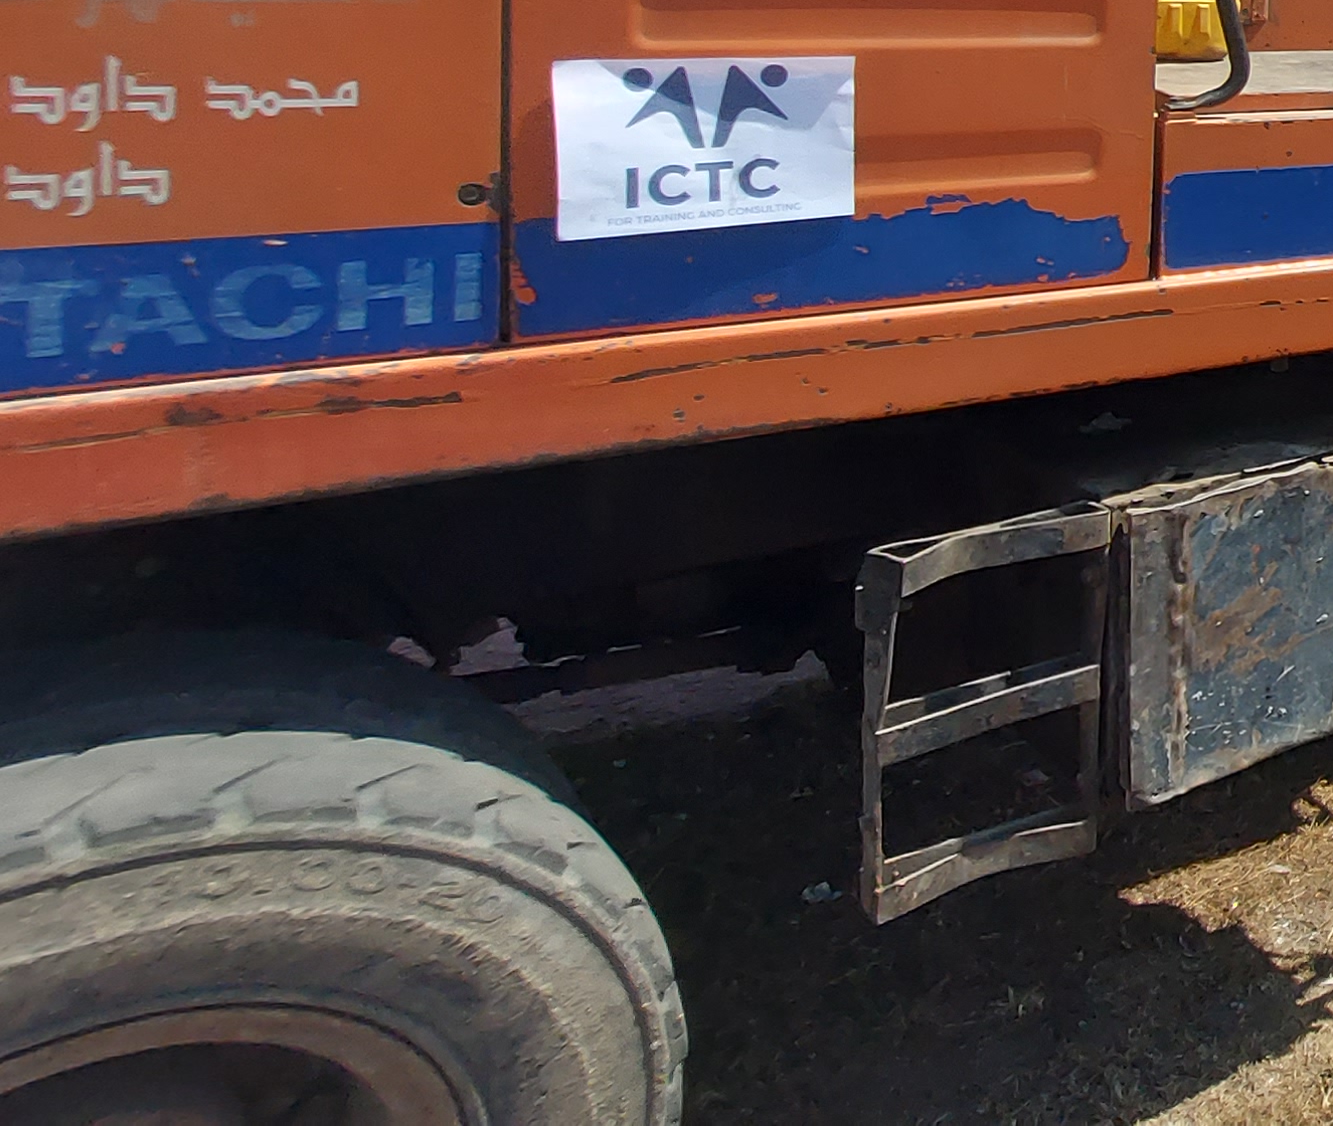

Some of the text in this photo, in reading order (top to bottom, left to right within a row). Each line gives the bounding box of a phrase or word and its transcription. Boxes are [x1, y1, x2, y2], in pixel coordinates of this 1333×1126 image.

[9, 54, 360, 132] محمد داود
[3, 140, 172, 217] داود
[625, 157, 781, 209] ICTC
[607, 201, 803, 227] FOR TRAINING AND CONSULTING
